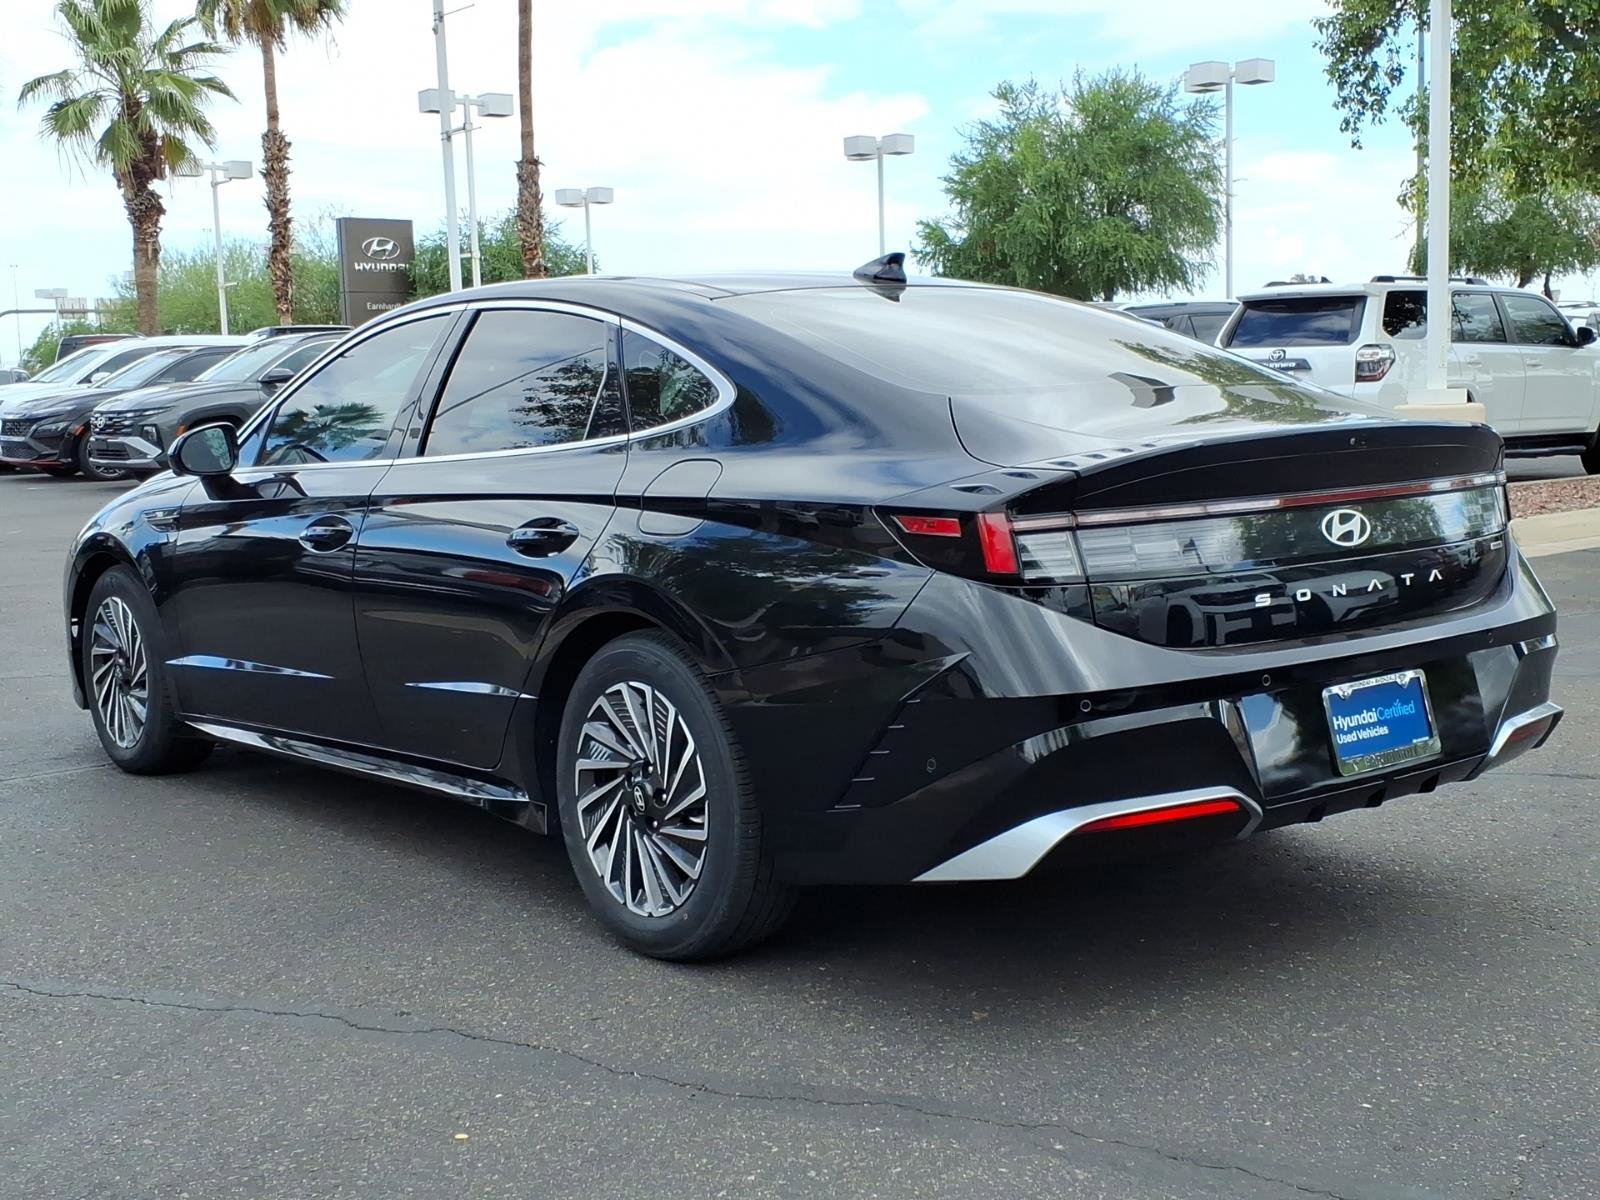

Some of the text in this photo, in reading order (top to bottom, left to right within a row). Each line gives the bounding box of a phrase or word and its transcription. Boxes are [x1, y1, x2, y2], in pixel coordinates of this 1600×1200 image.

[354, 262, 409, 272] HYUNDAI
[1254, 569, 1443, 608] SONATA
[1336, 725, 1389, 744] Used Vehicles
